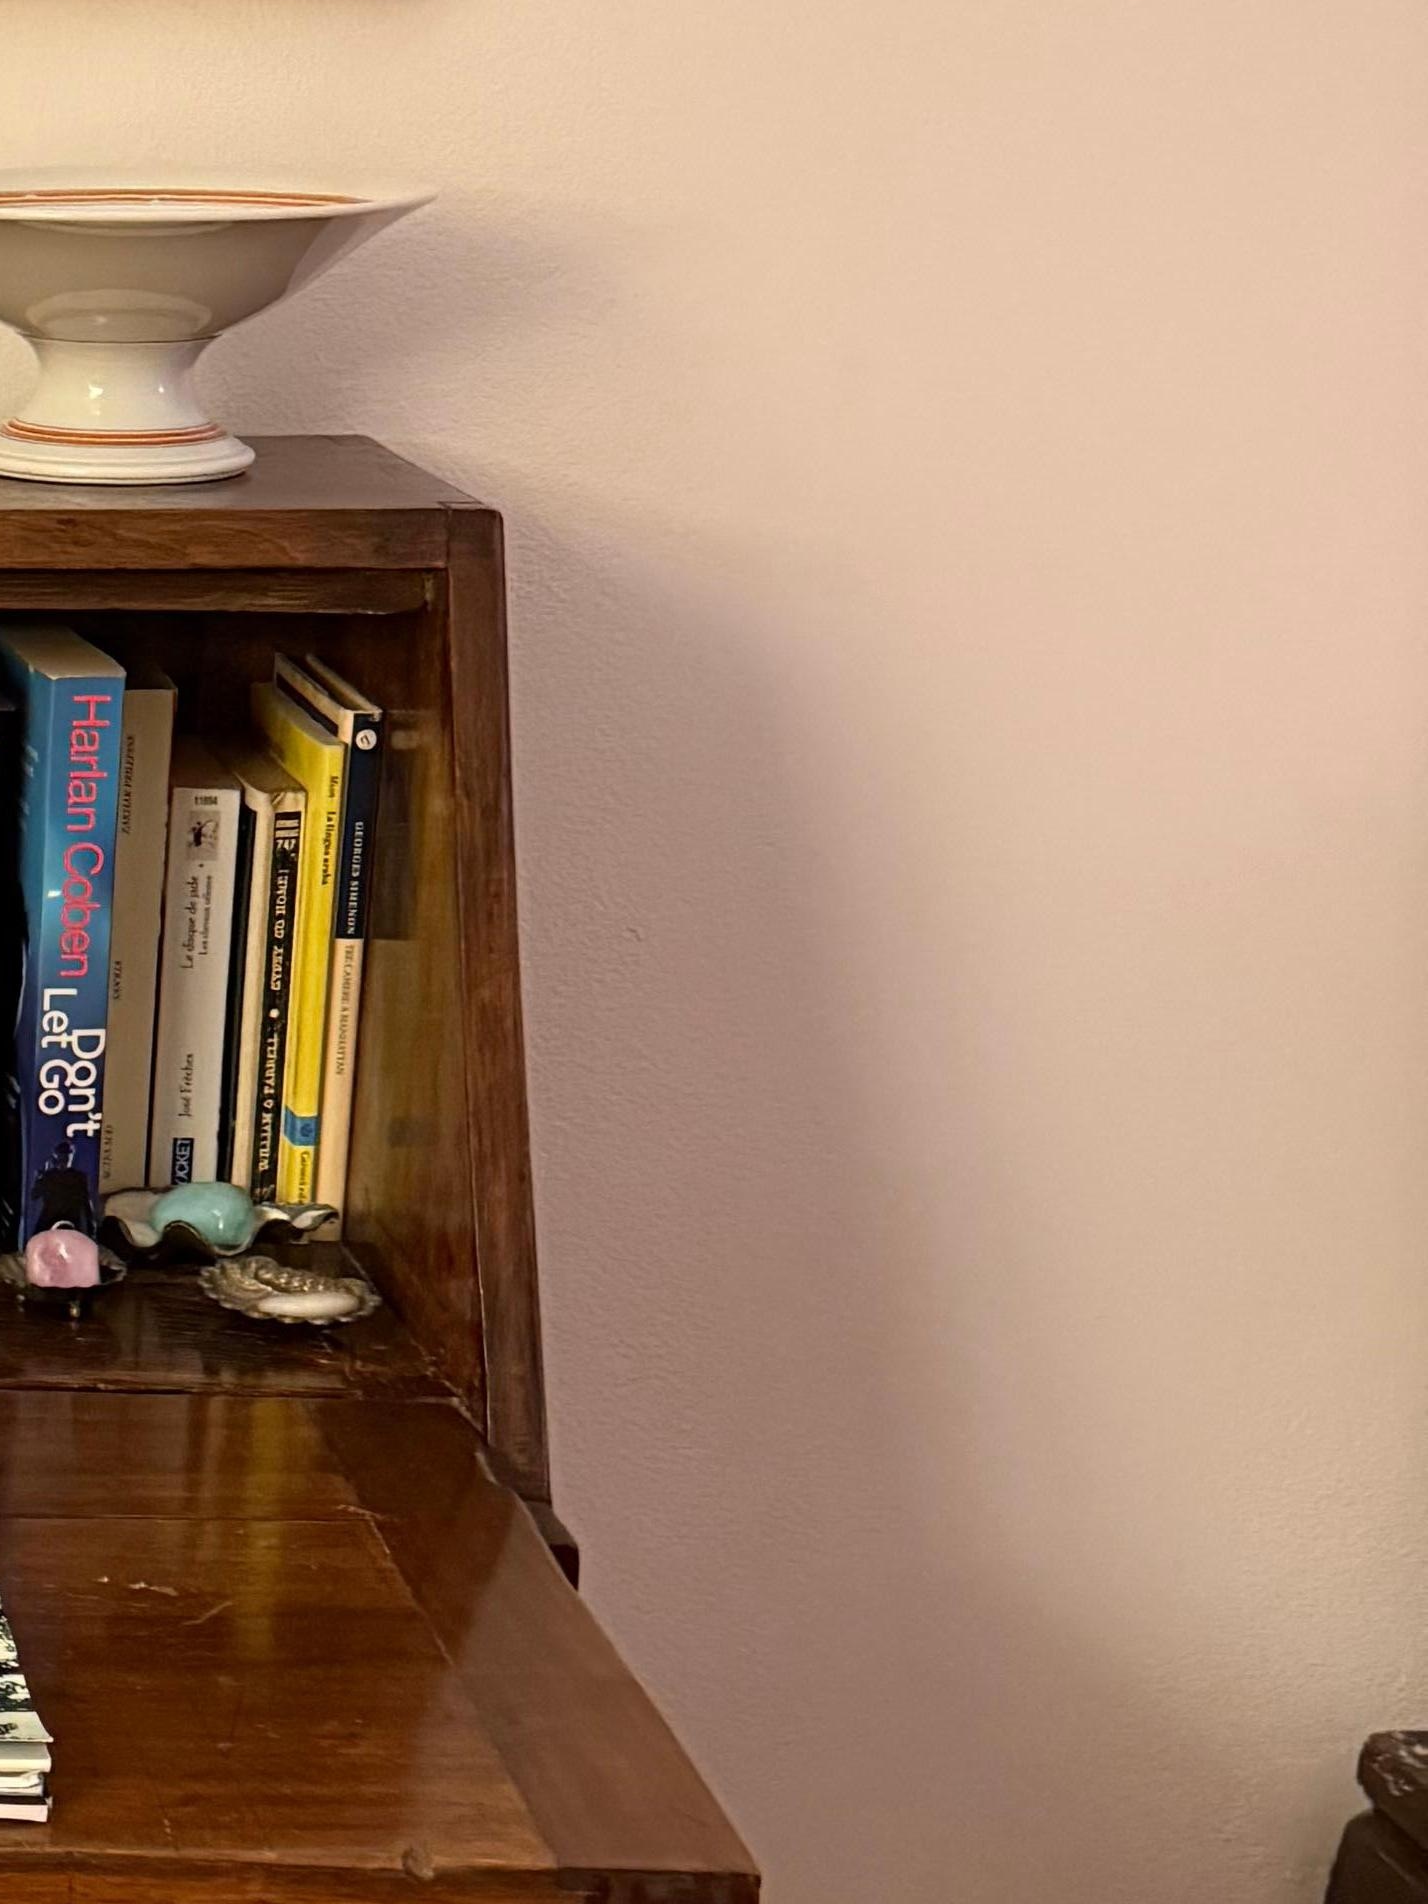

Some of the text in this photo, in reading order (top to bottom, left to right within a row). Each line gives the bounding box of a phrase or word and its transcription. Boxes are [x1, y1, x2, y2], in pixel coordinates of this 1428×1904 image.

[58, 694, 112, 977] Harlan Coben
[321, 823, 335, 856] lingua
[326, 810, 337, 822] La
[320, 856, 332, 886] araba
[347, 820, 365, 936] GEORGES SIMENON
[181, 876, 200, 969] Le disque de jade
[37, 986, 78, 1115] Let Go
[65, 1027, 107, 1138] Don't
